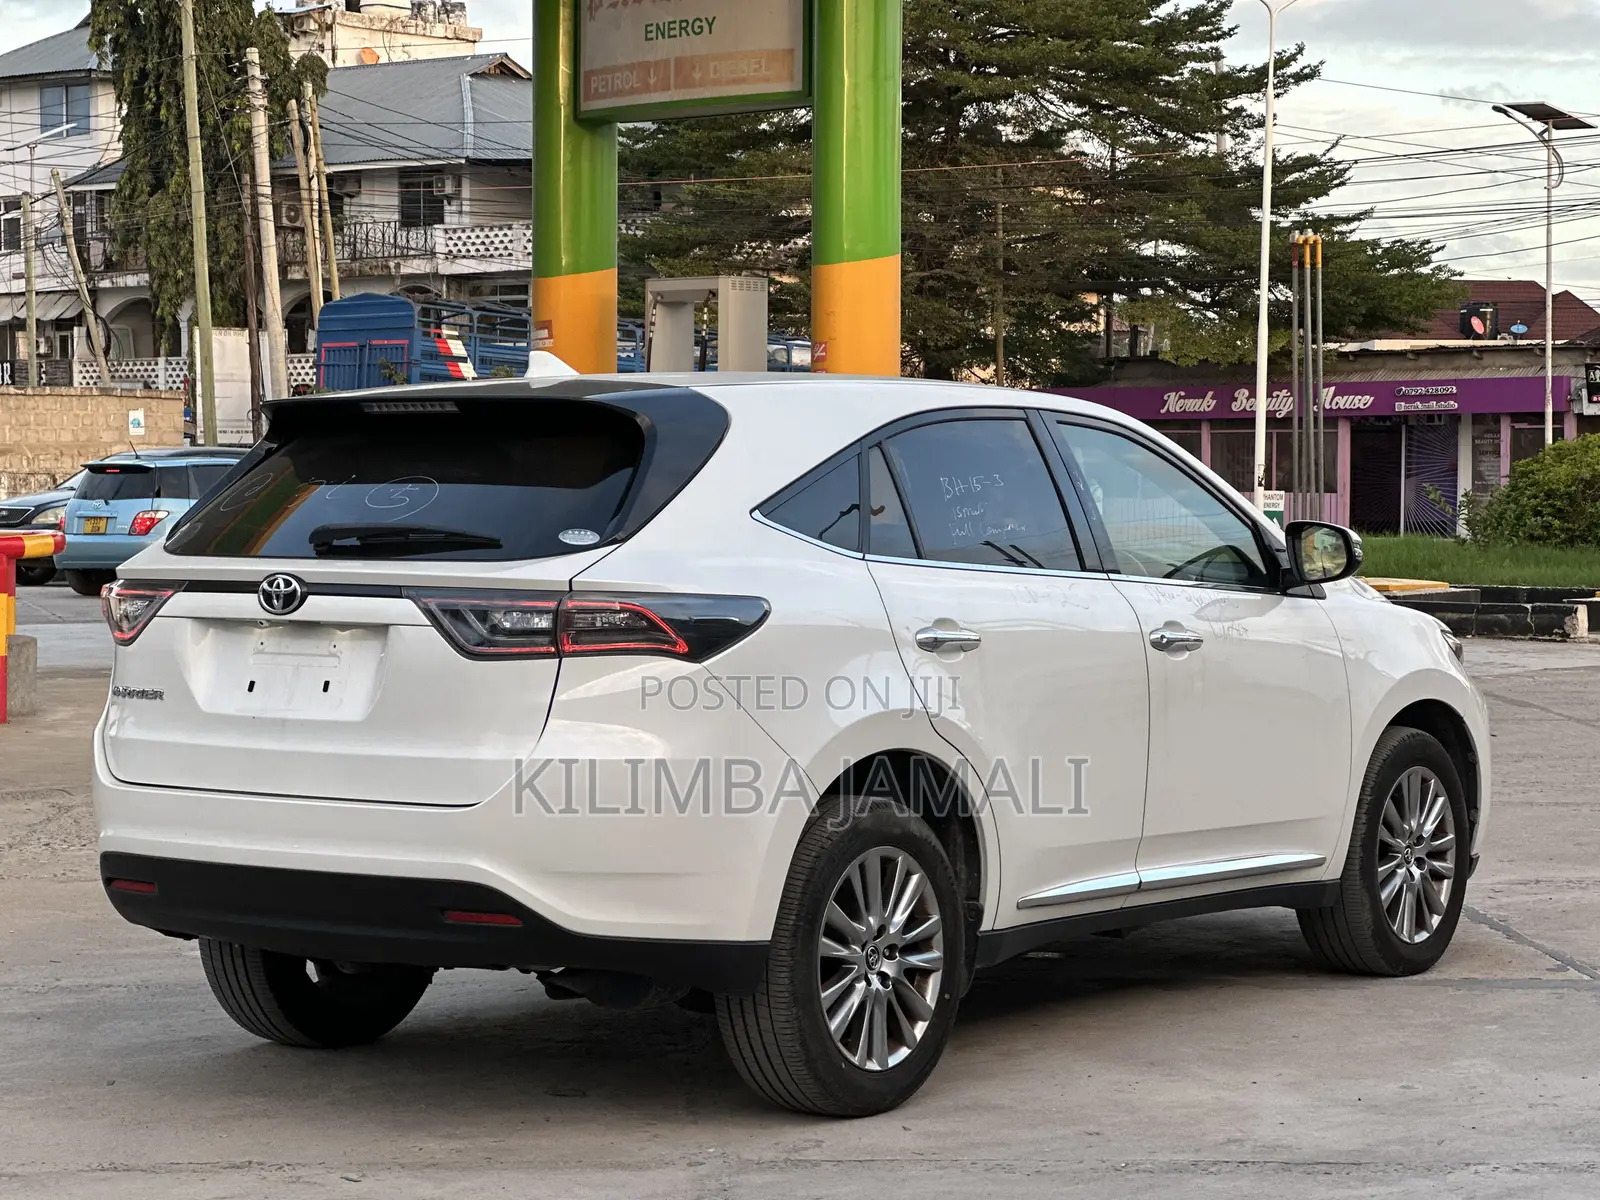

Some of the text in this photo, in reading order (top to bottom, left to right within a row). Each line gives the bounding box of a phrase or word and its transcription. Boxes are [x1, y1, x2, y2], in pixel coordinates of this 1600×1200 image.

[644, 16, 717, 42] ENERGY
[709, 57, 771, 79] DIESEL
[590, 73, 641, 94] PETROL
[1160, 391, 1217, 414] Nerak
[1231, 388, 1294, 418] Beuty
